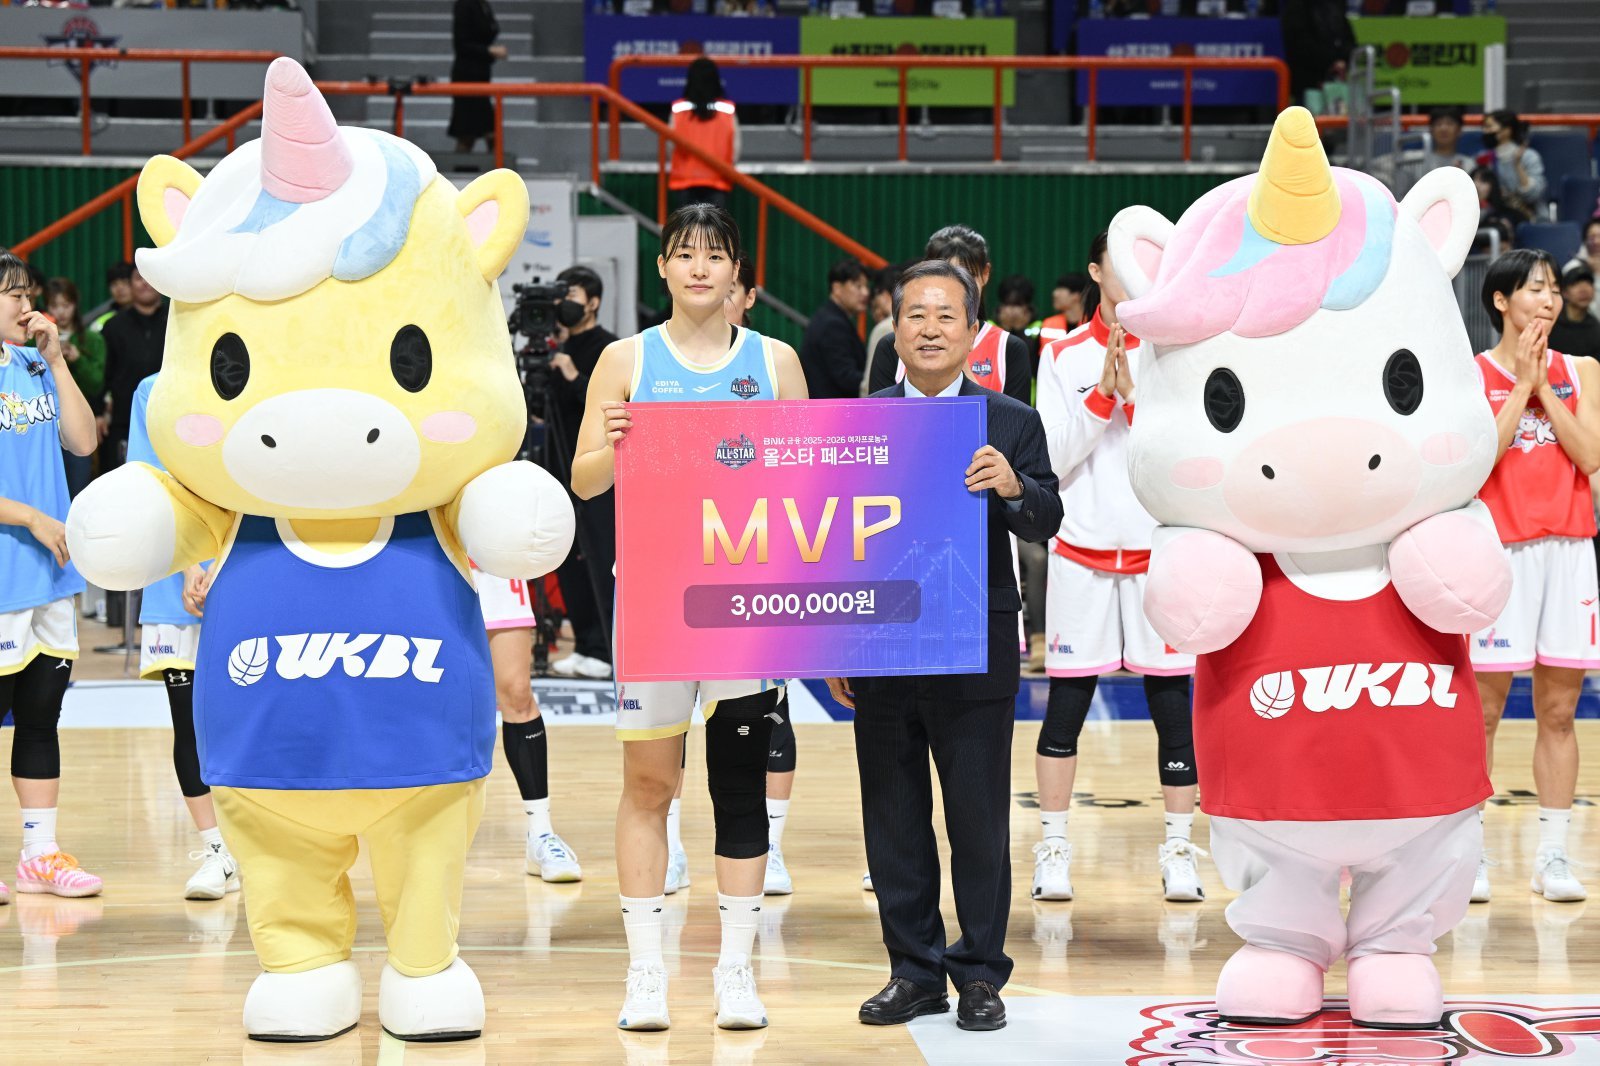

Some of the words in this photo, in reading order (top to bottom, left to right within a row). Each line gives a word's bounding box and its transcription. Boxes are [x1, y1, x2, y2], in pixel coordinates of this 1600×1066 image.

[763, 437, 786, 446] BNK
[787, 437, 802, 446] 금융
[803, 436, 846, 445] 2025-2026
[848, 435, 888, 444] 여자프로농구
[763, 448, 815, 468] 올스타
[820, 446, 889, 466] 페스티벌
[702, 495, 901, 565] MVP
[730, 589, 875, 621] 3,000,000원
[0, 640, 18, 651] KBL
[274, 632, 445, 684] WKBL
[1297, 661, 1458, 713] WKBL
[623, 699, 642, 711] KBL
